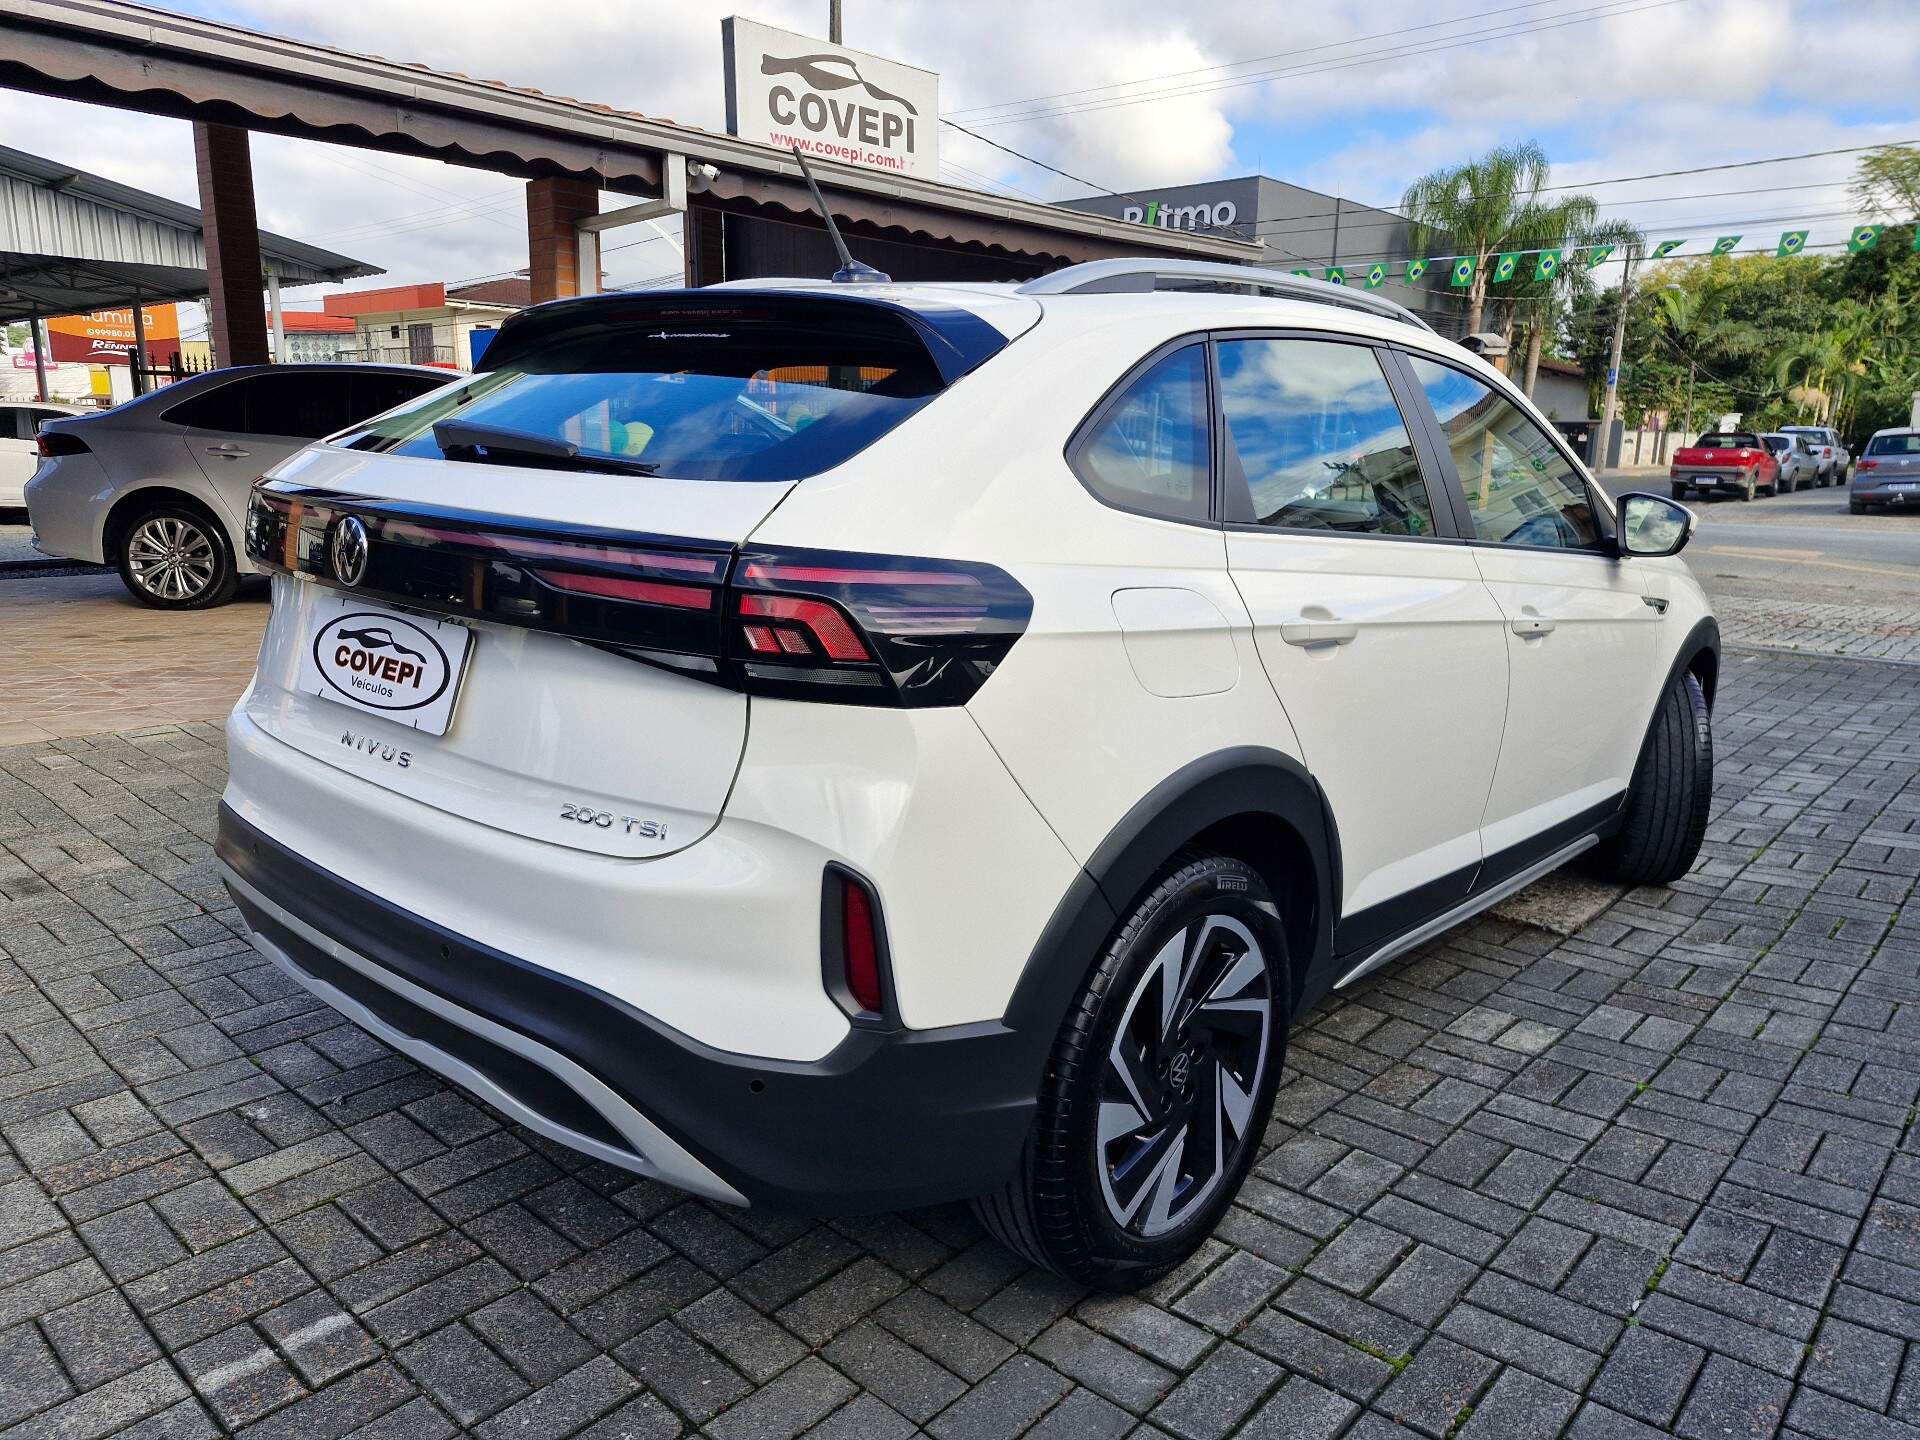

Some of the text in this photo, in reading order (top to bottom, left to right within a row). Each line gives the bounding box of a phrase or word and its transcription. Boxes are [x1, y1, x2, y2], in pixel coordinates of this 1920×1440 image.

[768, 85, 915, 153] COVEPI
[769, 131, 913, 171] www.covepi.com.b
[92, 339, 138, 351] RENNE
[334, 645, 424, 689] COVEPI
[351, 674, 394, 698] Veículos
[340, 729, 413, 769] NIVUS
[560, 802, 669, 840] 200 TSI
